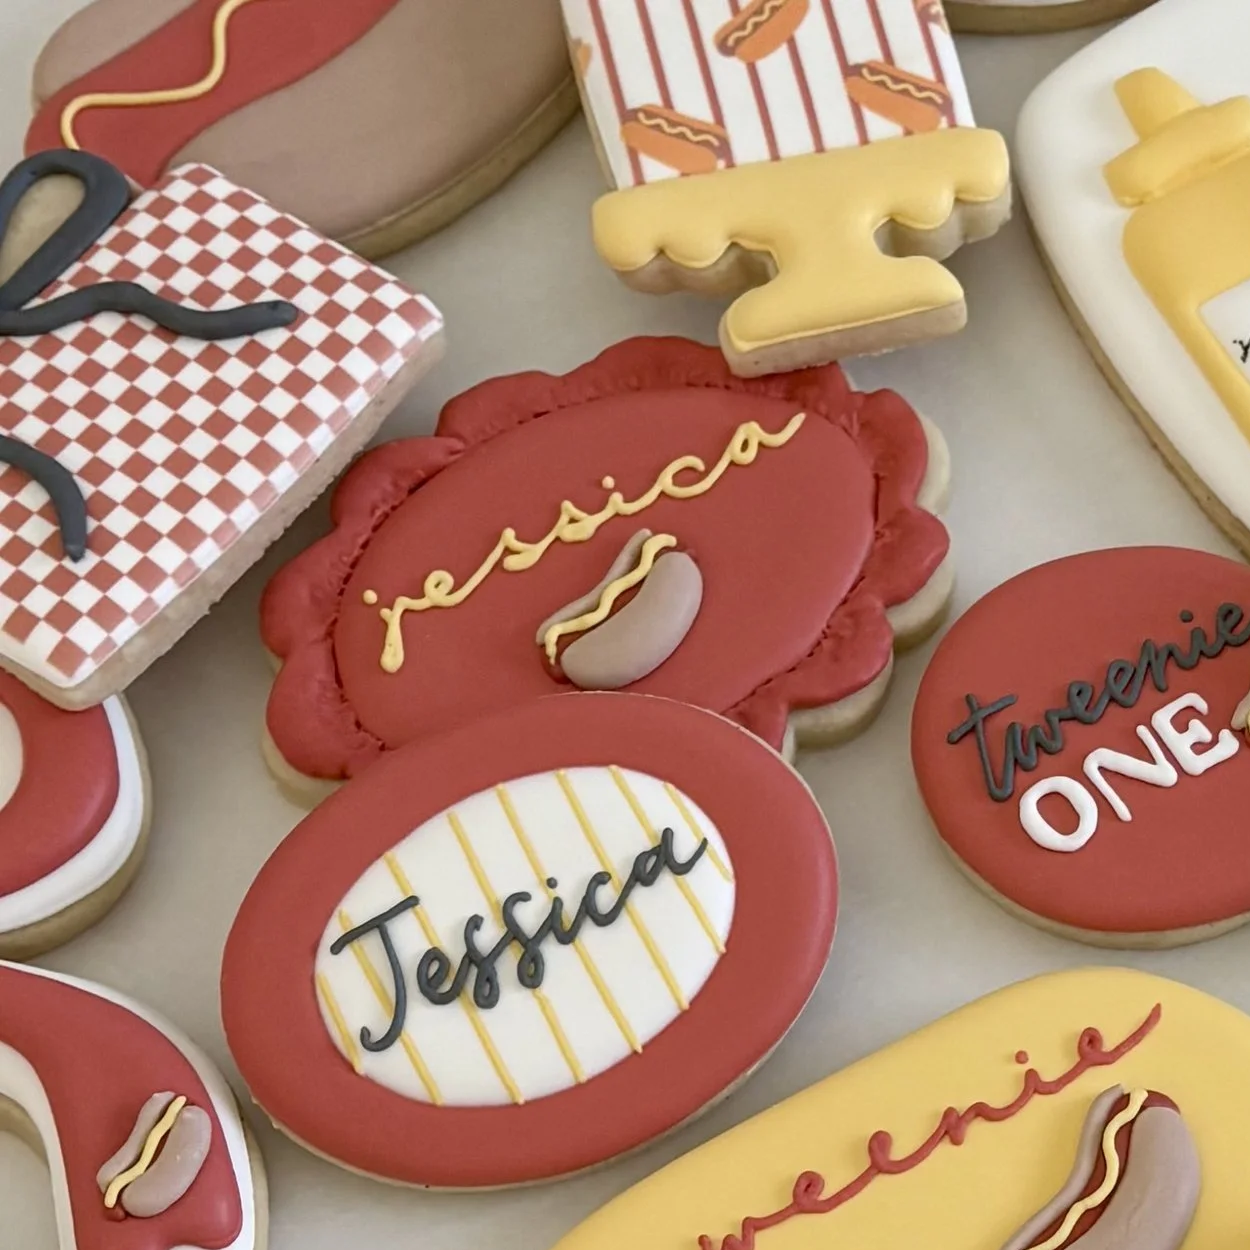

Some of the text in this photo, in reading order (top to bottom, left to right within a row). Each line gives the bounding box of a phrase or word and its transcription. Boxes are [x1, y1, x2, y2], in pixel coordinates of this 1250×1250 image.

[362, 412, 807, 674] jessica
[1019, 692, 1240, 853] ONE
[330, 827, 709, 1053] Jessica
